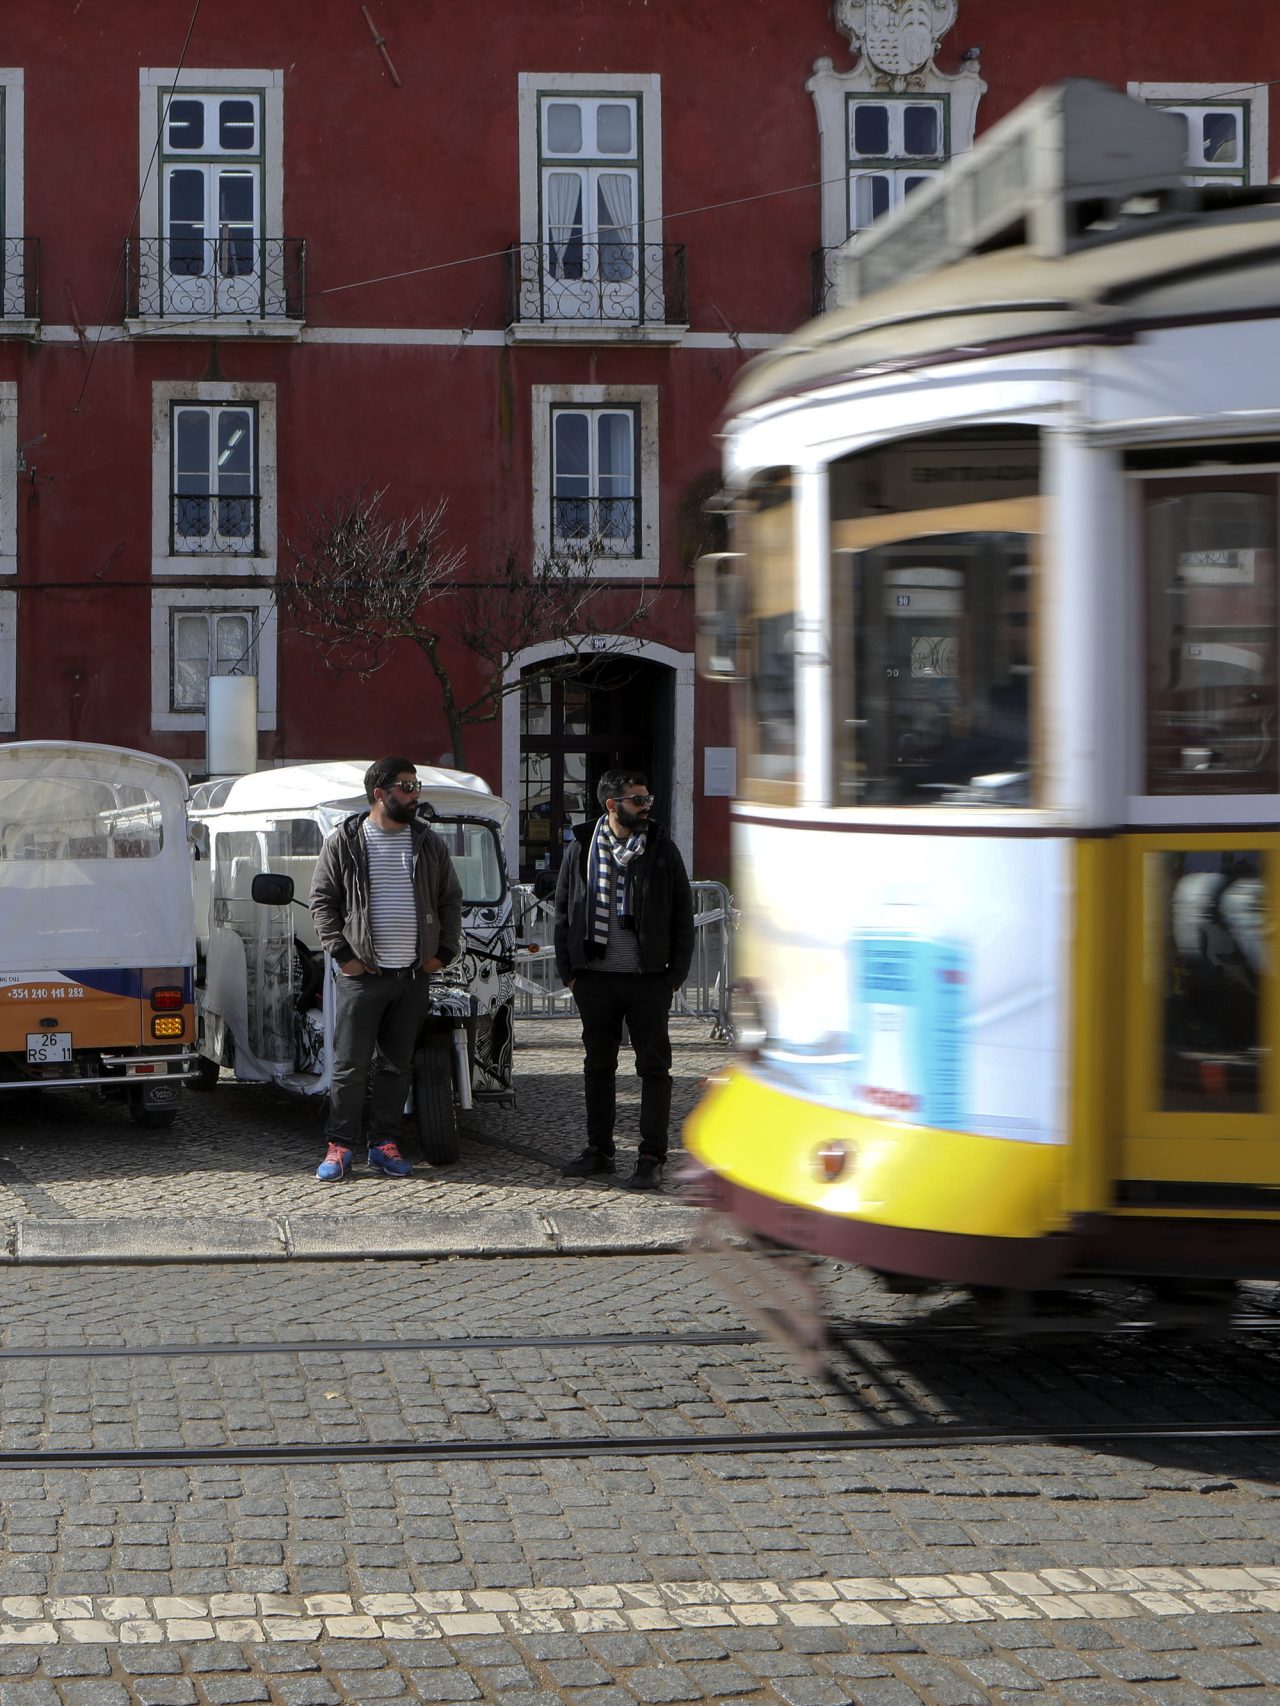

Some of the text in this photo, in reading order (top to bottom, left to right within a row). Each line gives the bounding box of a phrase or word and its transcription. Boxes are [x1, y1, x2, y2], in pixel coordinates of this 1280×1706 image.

[898, 595, 908, 605] 90
[8, 988, 28, 998] +351
[68, 988, 84, 997] 282
[42, 1034, 57, 1046] 26
[29, 1048, 71, 1061] RS 11
